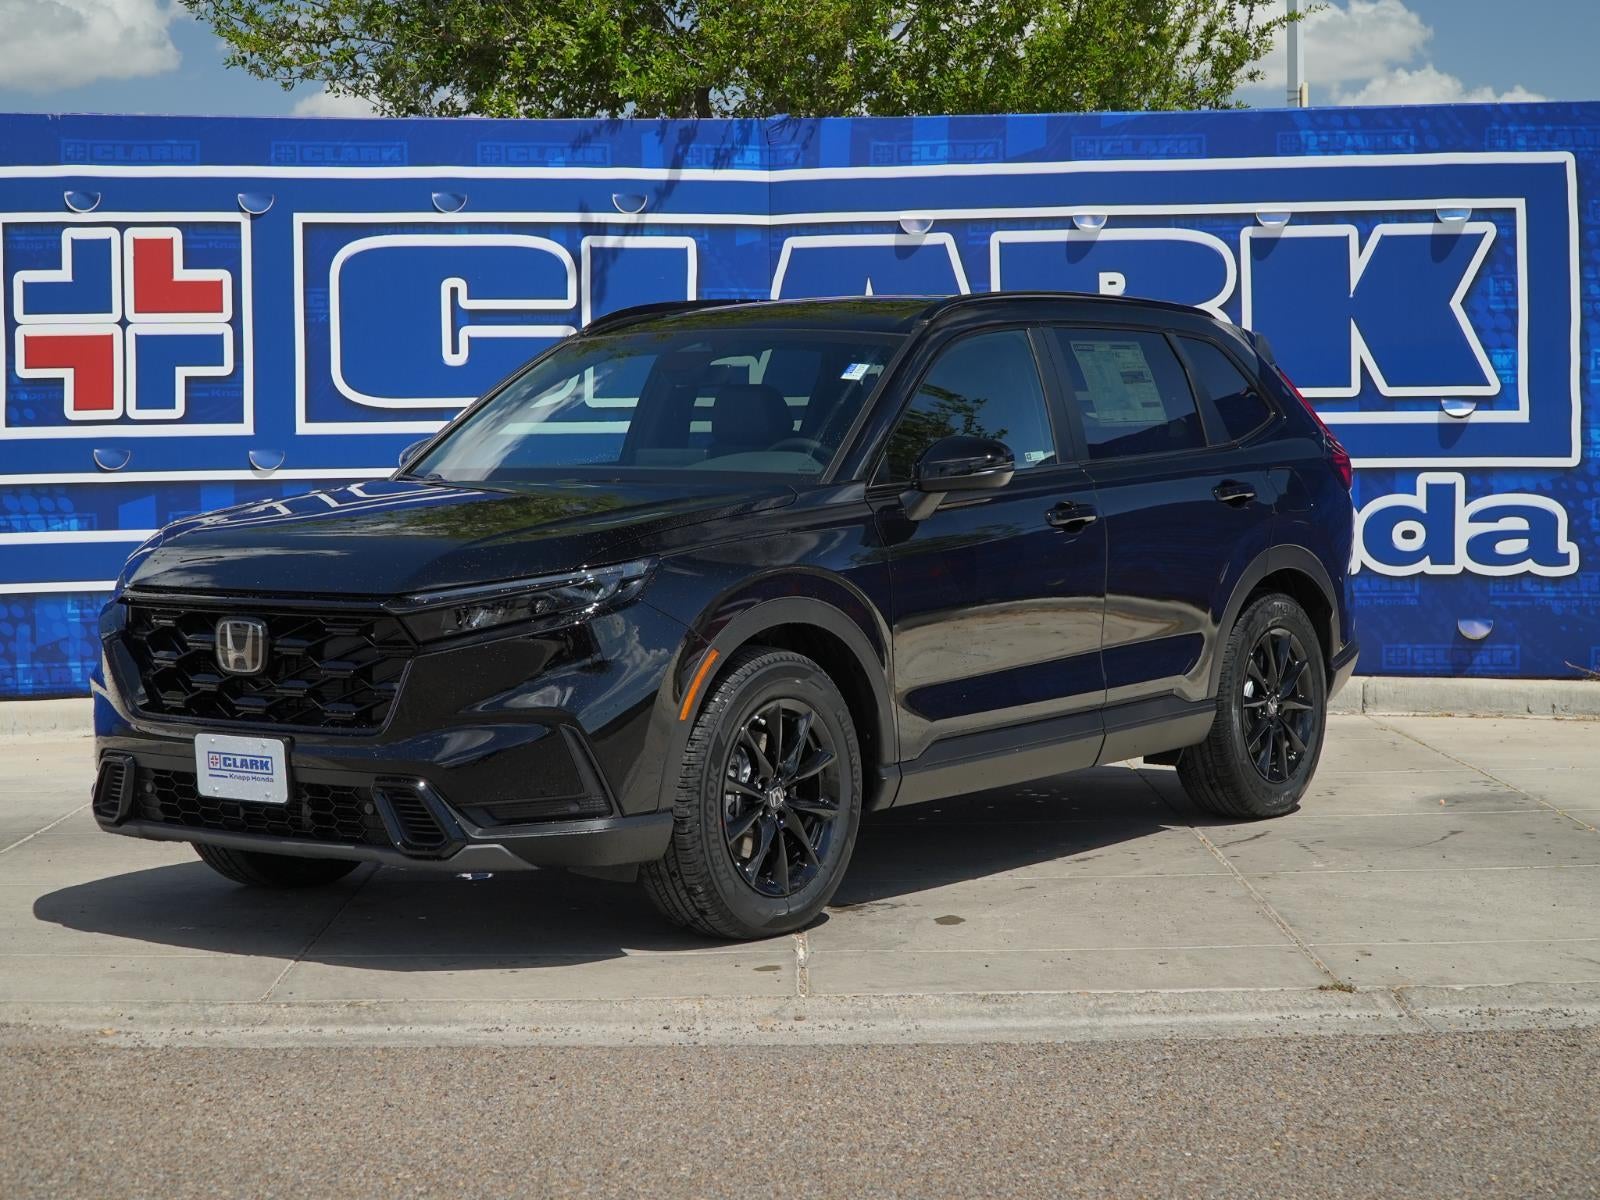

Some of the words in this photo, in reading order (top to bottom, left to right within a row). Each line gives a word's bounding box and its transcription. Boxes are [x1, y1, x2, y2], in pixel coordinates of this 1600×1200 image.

[92, 145, 193, 161] CLARK
[302, 146, 403, 161] CLARK
[898, 142, 997, 160] CLARK
[1102, 138, 1201, 156] CLARK
[222, 756, 271, 771] CLARK
[229, 773, 251, 783] Knapp
[251, 775, 274, 783] Honda
